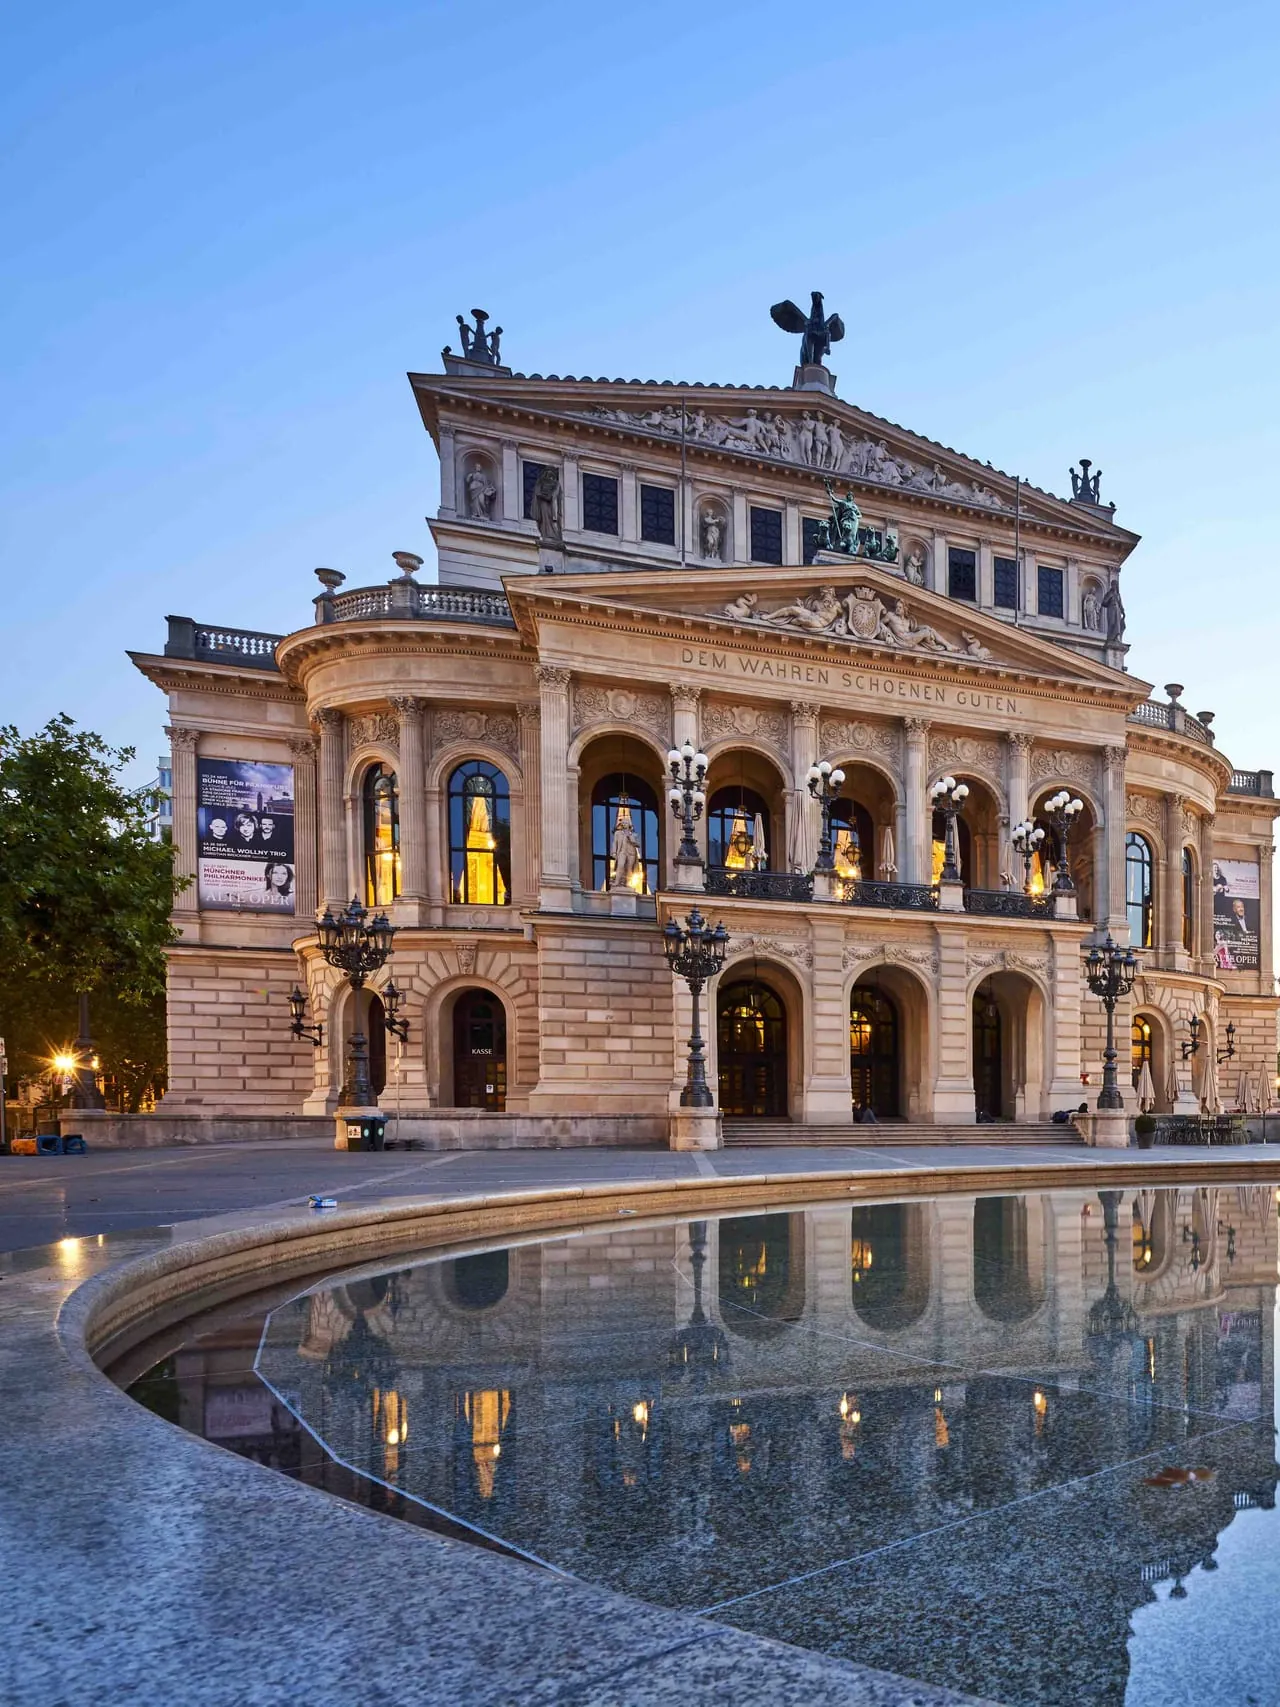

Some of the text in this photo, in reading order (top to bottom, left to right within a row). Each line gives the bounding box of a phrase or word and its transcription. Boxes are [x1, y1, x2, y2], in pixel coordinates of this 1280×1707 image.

[682, 648, 1024, 715] DEM WAHREN SCHOENEN GUTEN.
[202, 777, 228, 786] BÜHNE
[203, 846, 235, 854] MICHAEL
[237, 848, 268, 856] WOLLNY
[203, 867, 246, 875] MÜNCHNER
[206, 891, 246, 903] ALTE
[249, 893, 290, 906] OPER
[1235, 955, 1257, 964] OPER
